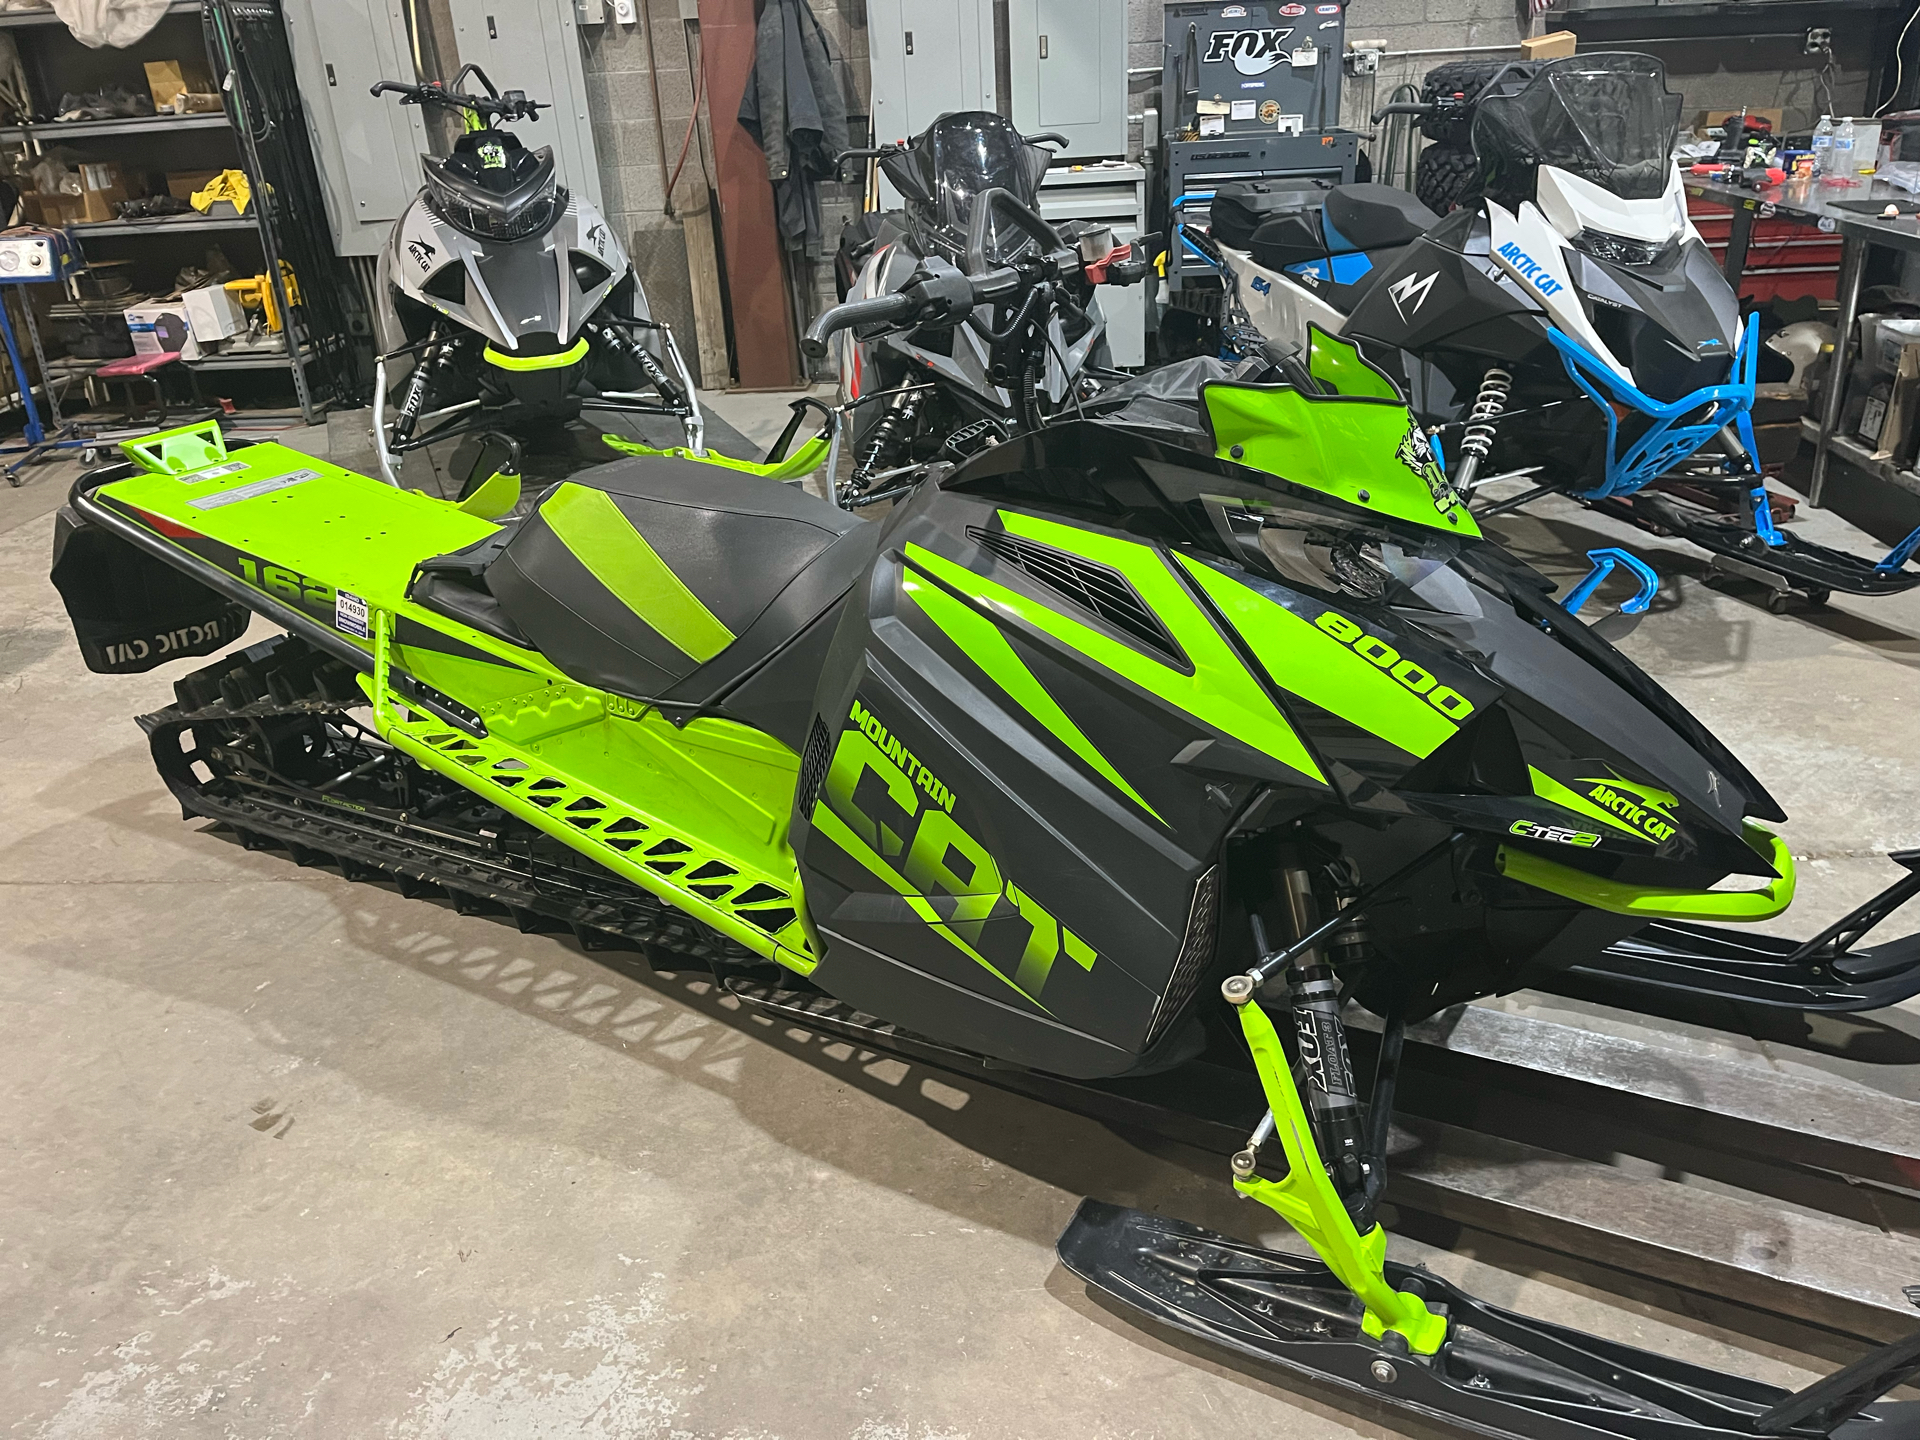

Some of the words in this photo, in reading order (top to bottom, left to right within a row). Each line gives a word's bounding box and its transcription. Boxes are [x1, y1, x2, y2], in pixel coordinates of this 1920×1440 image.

[1204, 27, 1295, 63] FOX
[408, 244, 423, 264] ARCTIC
[420, 260, 430, 273] CAT
[1497, 241, 1542, 279] ARCTIC
[1534, 274, 1563, 297] CAT
[1587, 293, 1622, 308] CATALYST
[405, 383, 422, 416] FOX
[238, 557, 336, 611] 162
[340, 599, 365, 618] 014930
[1314, 610, 1475, 720] 8000
[849, 699, 957, 814] MOUNTAIN
[1509, 820, 1602, 848] C-TEC2
[1588, 785, 1647, 825] ARCTIC
[1643, 818, 1676, 842] CAT
[1293, 1006, 1328, 1094] FOX
[1324, 1031, 1343, 1086] FLOAT
